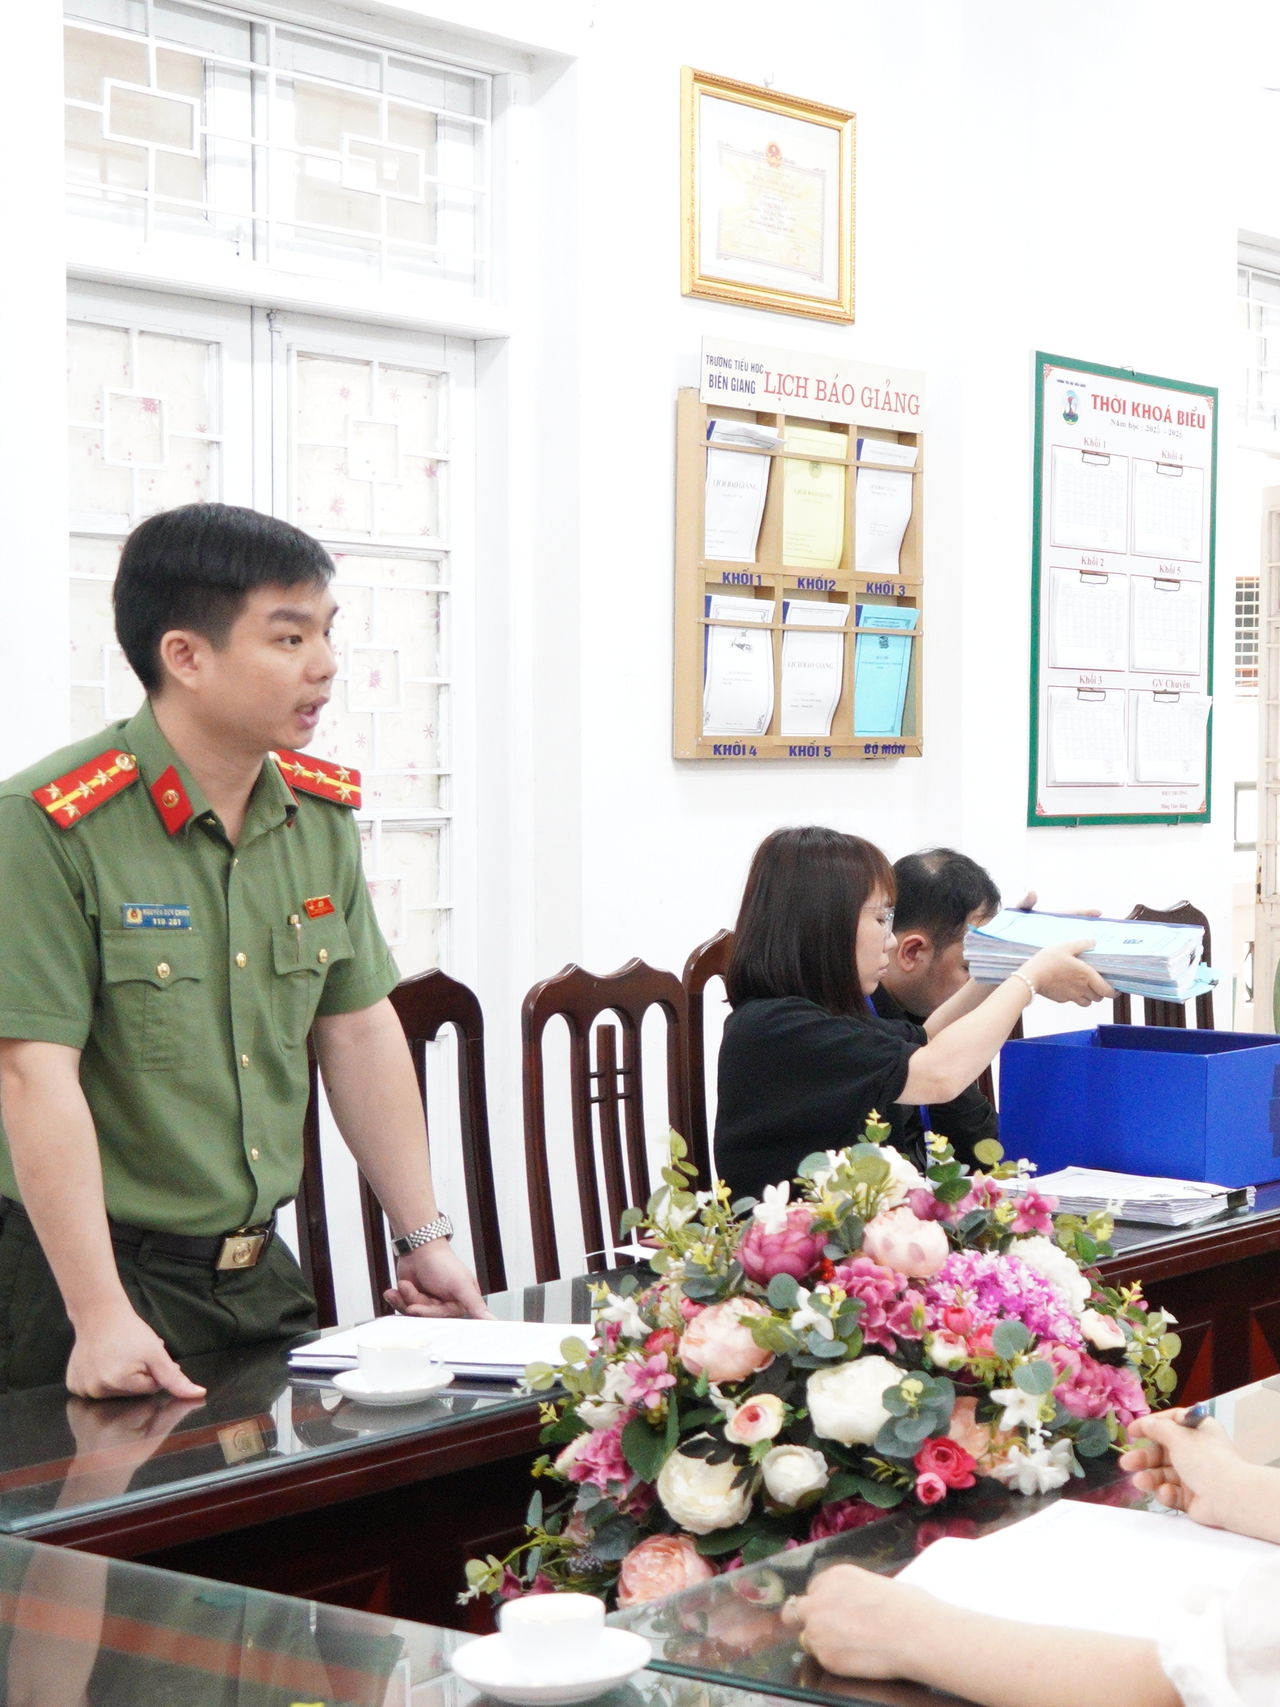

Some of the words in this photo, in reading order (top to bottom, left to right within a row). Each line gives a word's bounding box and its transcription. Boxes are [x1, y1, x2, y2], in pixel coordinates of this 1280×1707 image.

[706, 354, 732, 370] TRƯỜNG
[734, 356, 749, 372] TIỂU
[751, 363, 764, 376] HỌC
[709, 372, 728, 390] BIÊN
[731, 377, 756, 394] GIANG
[763, 371, 810, 402] LỊCH
[815, 373, 855, 405] BÁO
[861, 379, 920, 415] GIẢNG
[1091, 394, 1126, 415] THỜI
[1131, 404, 1172, 424] KHOÁ
[1177, 406, 1206, 430] BIỂU
[1110, 418, 1127, 428] Năm
[1128, 422, 1139, 431] học
[1083, 436, 1101, 448] Khối
[1161, 449, 1178, 460] Khối
[1178, 453, 1183, 461] 4
[1081, 554, 1098, 566] Khối
[1100, 558, 1104, 567] 2
[1159, 563, 1176, 574] Khối
[1177, 566, 1181, 575] 5
[722, 568, 754, 585] KHỐI
[758, 574, 763, 586] 1
[866, 580, 895, 596] KHỐI
[899, 585, 906, 596] 3
[1079, 673, 1096, 685] Khối
[1098, 676, 1103, 685] 3
[1152, 679, 1163, 688] GV
[1165, 678, 1191, 690] Chuyên
[713, 740, 746, 756] KHỐI
[749, 746, 757, 756] 4
[789, 742, 819, 757] KHỐI
[824, 746, 831, 758] 5
[864, 744, 879, 758] BỘ
